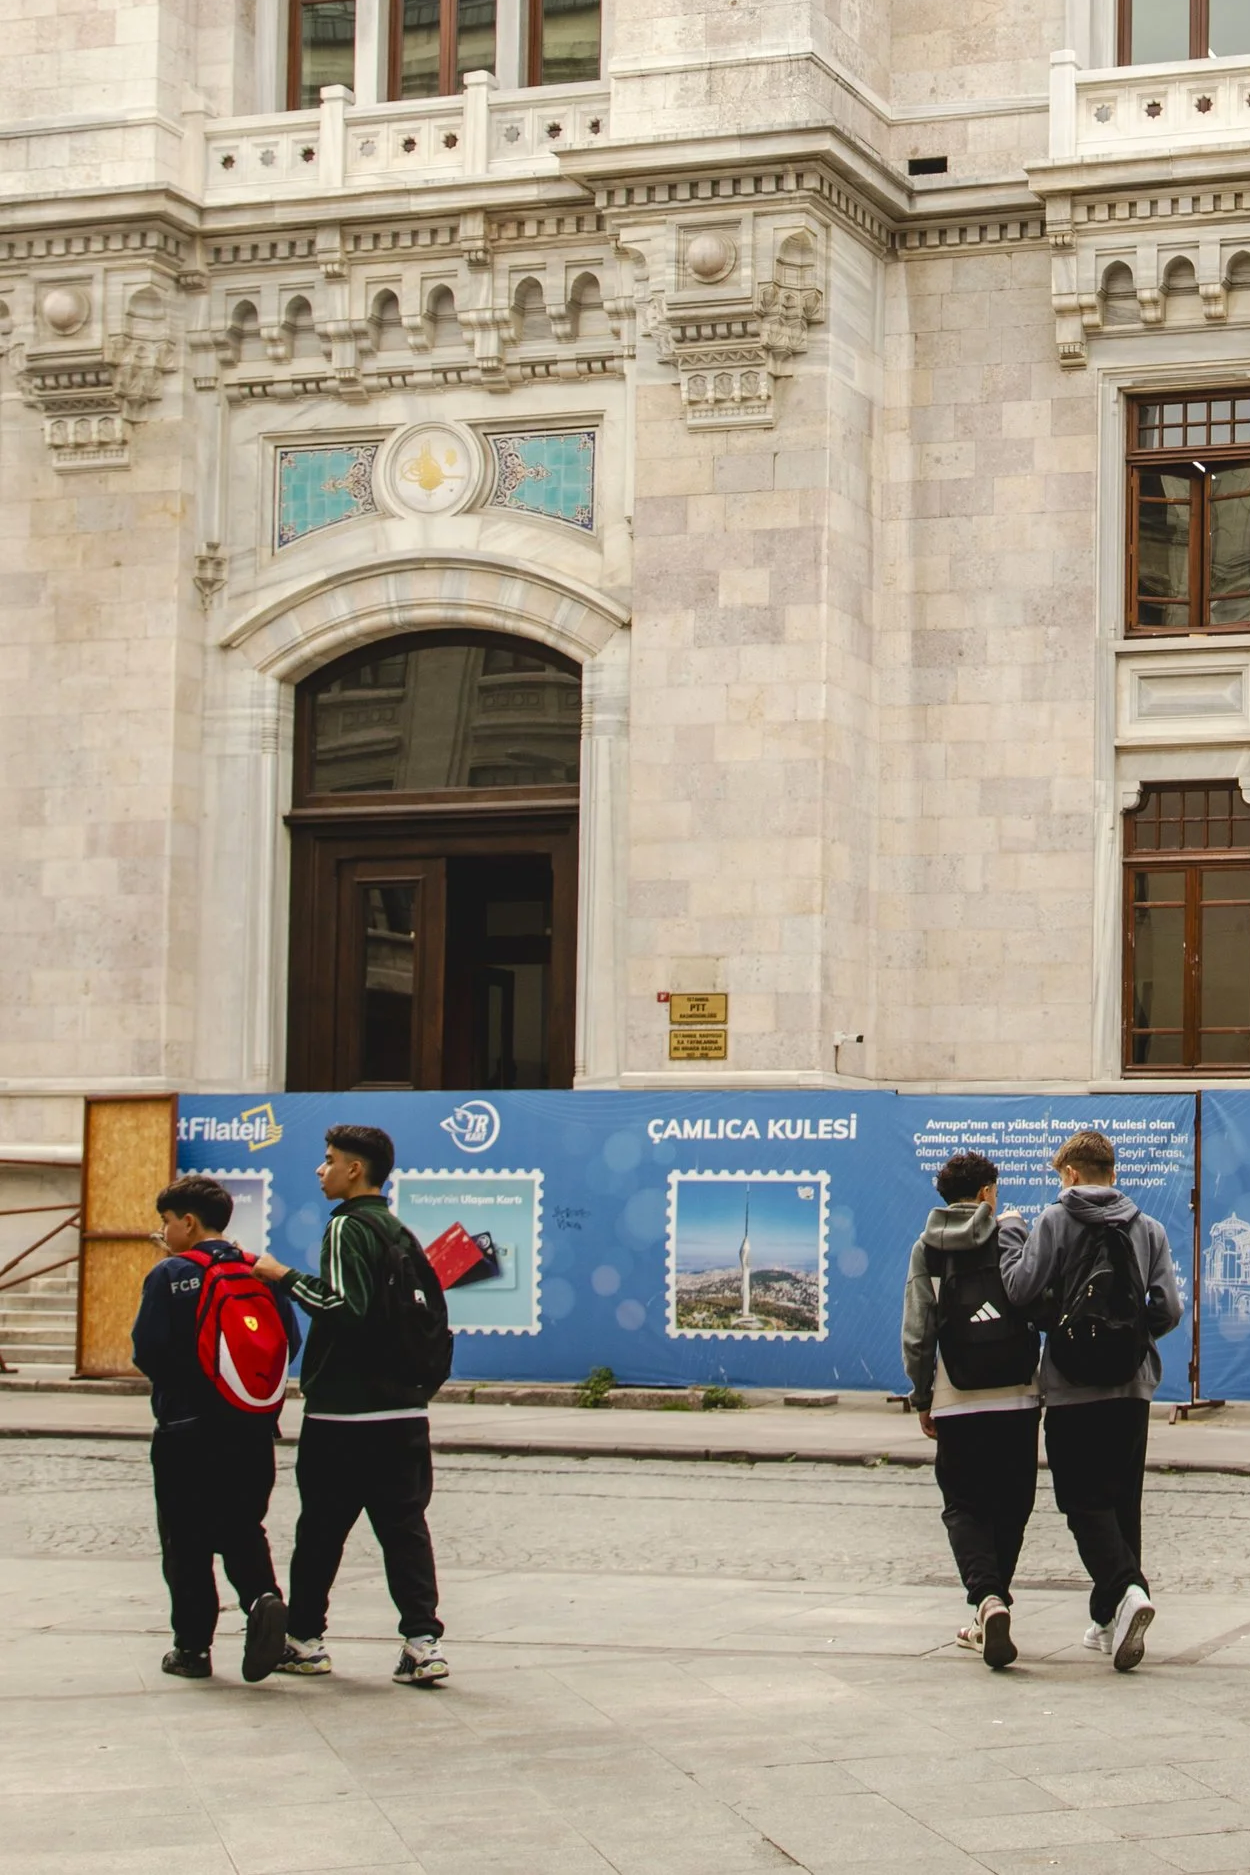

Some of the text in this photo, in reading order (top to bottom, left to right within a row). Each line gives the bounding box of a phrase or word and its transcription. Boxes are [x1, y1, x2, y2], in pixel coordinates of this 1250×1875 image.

[690, 1003, 706, 1012] PTT
[647, 1113, 857, 1144] ÇAMLICA KULESİ
[926, 1118, 1175, 1132] Avrupa'nın en yüksek Radyo-TV kulesi olan
[913, 1133, 958, 1145] Çamlıca
[961, 1133, 998, 1144] Kulesi,
[1001, 1131, 1062, 1143] İstanbul'un
[1170, 1133, 1188, 1143] biri
[915, 1146, 950, 1157] olarak
[951, 1147, 966, 1156] 20
[988, 1147, 1055, 1157] metrekarelik
[1118, 1147, 1146, 1160] Seyir
[1149, 1147, 1185, 1158] Terası,
[1030, 1163, 1044, 1171] ve
[1114, 1161, 1180, 1174] deneyimiyle
[1028, 1176, 1042, 1185] en
[1120, 1177, 1167, 1189] sunuyor.
[170, 1277, 200, 1294] FCB
